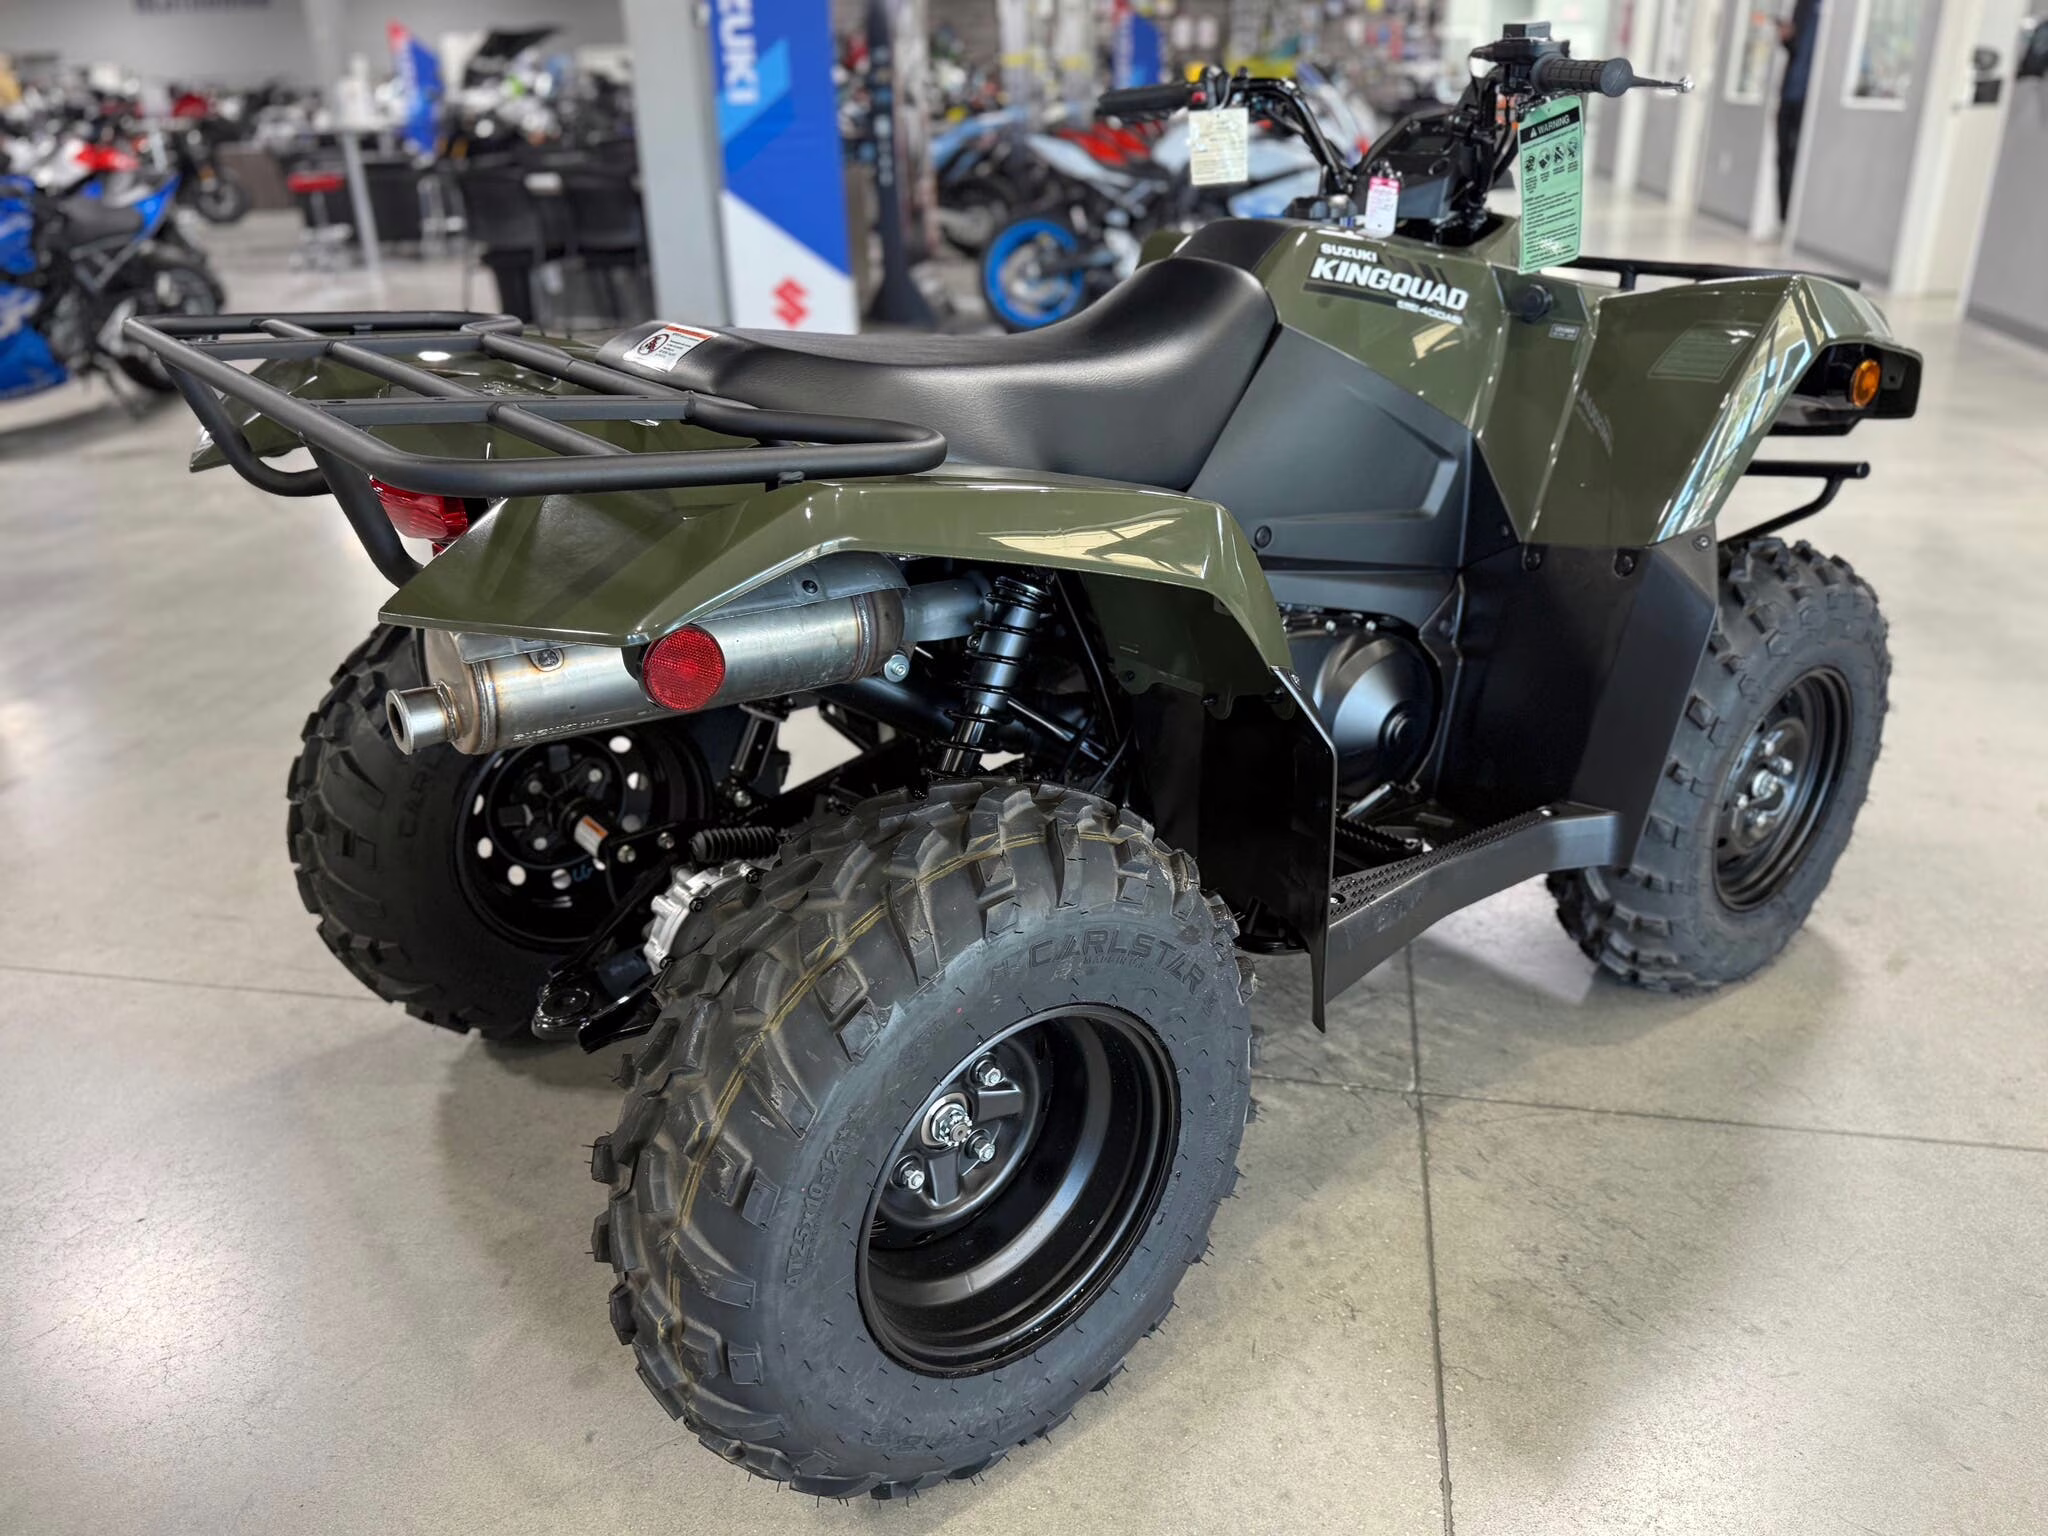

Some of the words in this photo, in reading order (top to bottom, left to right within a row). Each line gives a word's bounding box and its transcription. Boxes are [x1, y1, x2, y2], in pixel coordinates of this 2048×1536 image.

[1537, 114, 1571, 134] WARNING
[1320, 242, 1378, 264] SUZUKI
[1310, 257, 1469, 311] KINGQUAD
[1028, 928, 1206, 995] CARLSTAR
